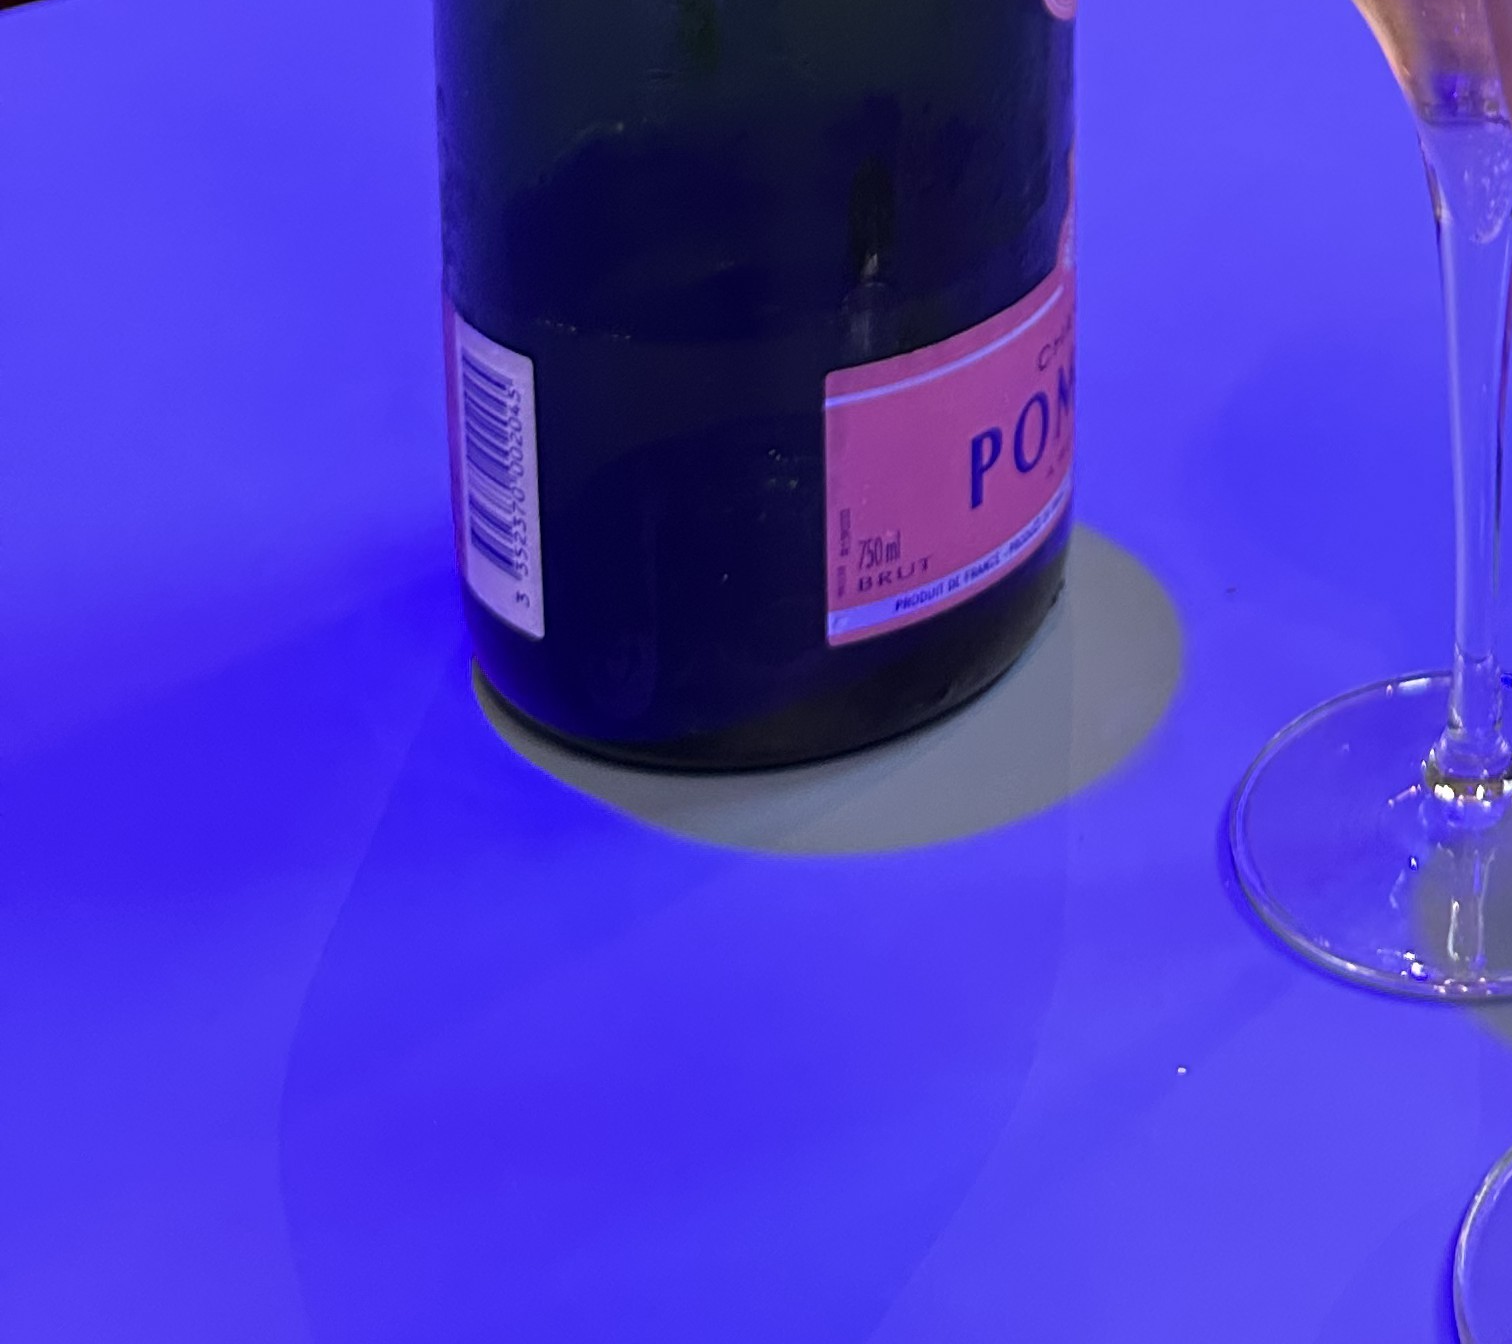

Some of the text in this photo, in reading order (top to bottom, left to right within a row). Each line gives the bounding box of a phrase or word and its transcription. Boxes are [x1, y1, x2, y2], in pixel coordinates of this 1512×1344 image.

[511, 486, 529, 577] 352370
[858, 555, 932, 593] BRUT
[515, 591, 531, 608] 3
[895, 581, 944, 612] PRODUIT
